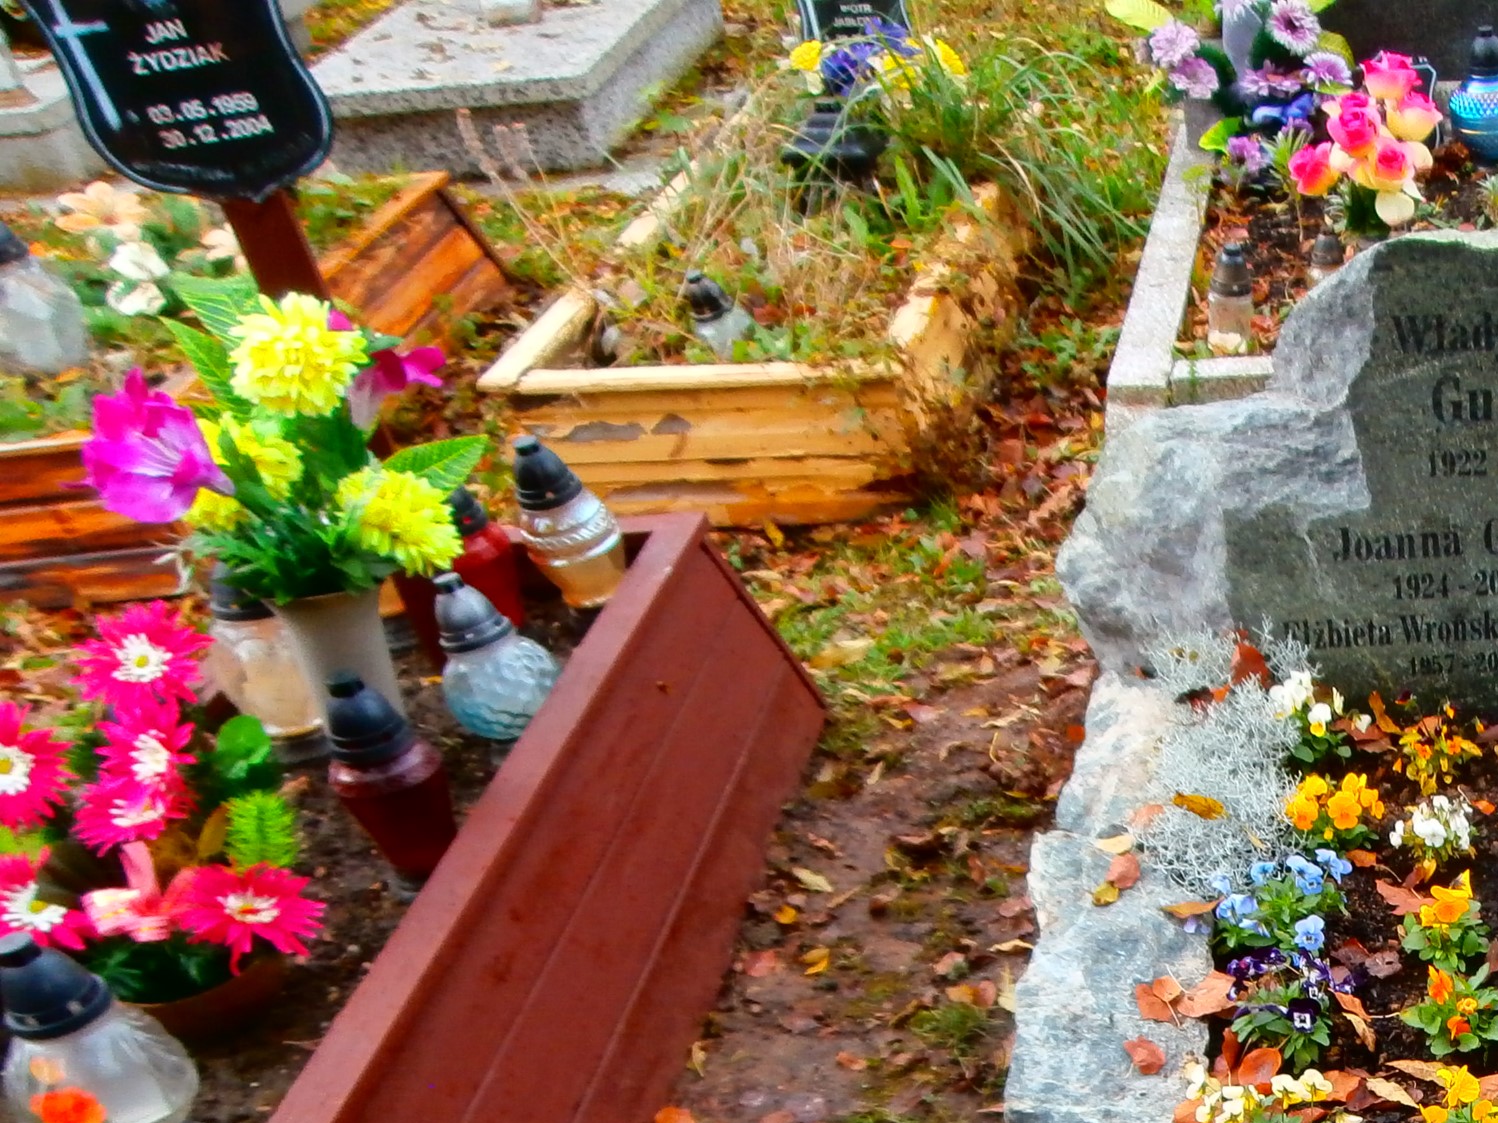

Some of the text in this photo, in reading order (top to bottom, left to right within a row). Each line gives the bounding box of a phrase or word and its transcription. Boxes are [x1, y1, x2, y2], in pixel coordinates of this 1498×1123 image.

[145, 18, 188, 44] JAN
[127, 42, 231, 76] ŻYDZIAK
[1429, 447, 1488, 477] 1922
[1333, 526, 1463, 562] Joanna
[1393, 572, 1449, 599] 1924
[1283, 617, 1393, 650] Elżbieta
